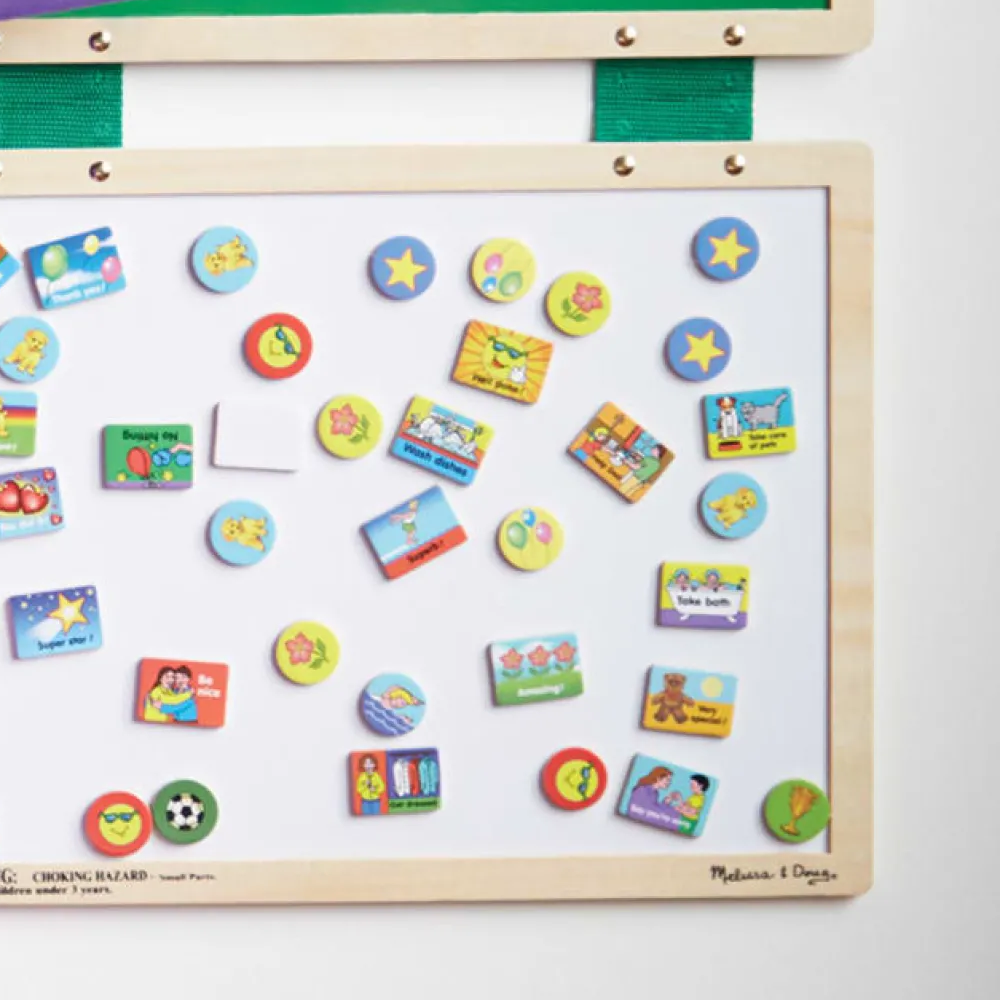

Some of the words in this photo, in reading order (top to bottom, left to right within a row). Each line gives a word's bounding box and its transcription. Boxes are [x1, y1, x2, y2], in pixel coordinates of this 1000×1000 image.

[404, 442, 432, 461] Wash
[434, 456, 467, 477] dishes
[37, 639, 66, 652] Super
[197, 673, 214, 686] Be
[197, 687, 221, 698] nice
[32, 870, 92, 883] CHOKING
[95, 870, 148, 882] HAZARD
[711, 865, 775, 885] Melissa
[35, 885, 67, 895] under
[72, 884, 78, 894] 3
